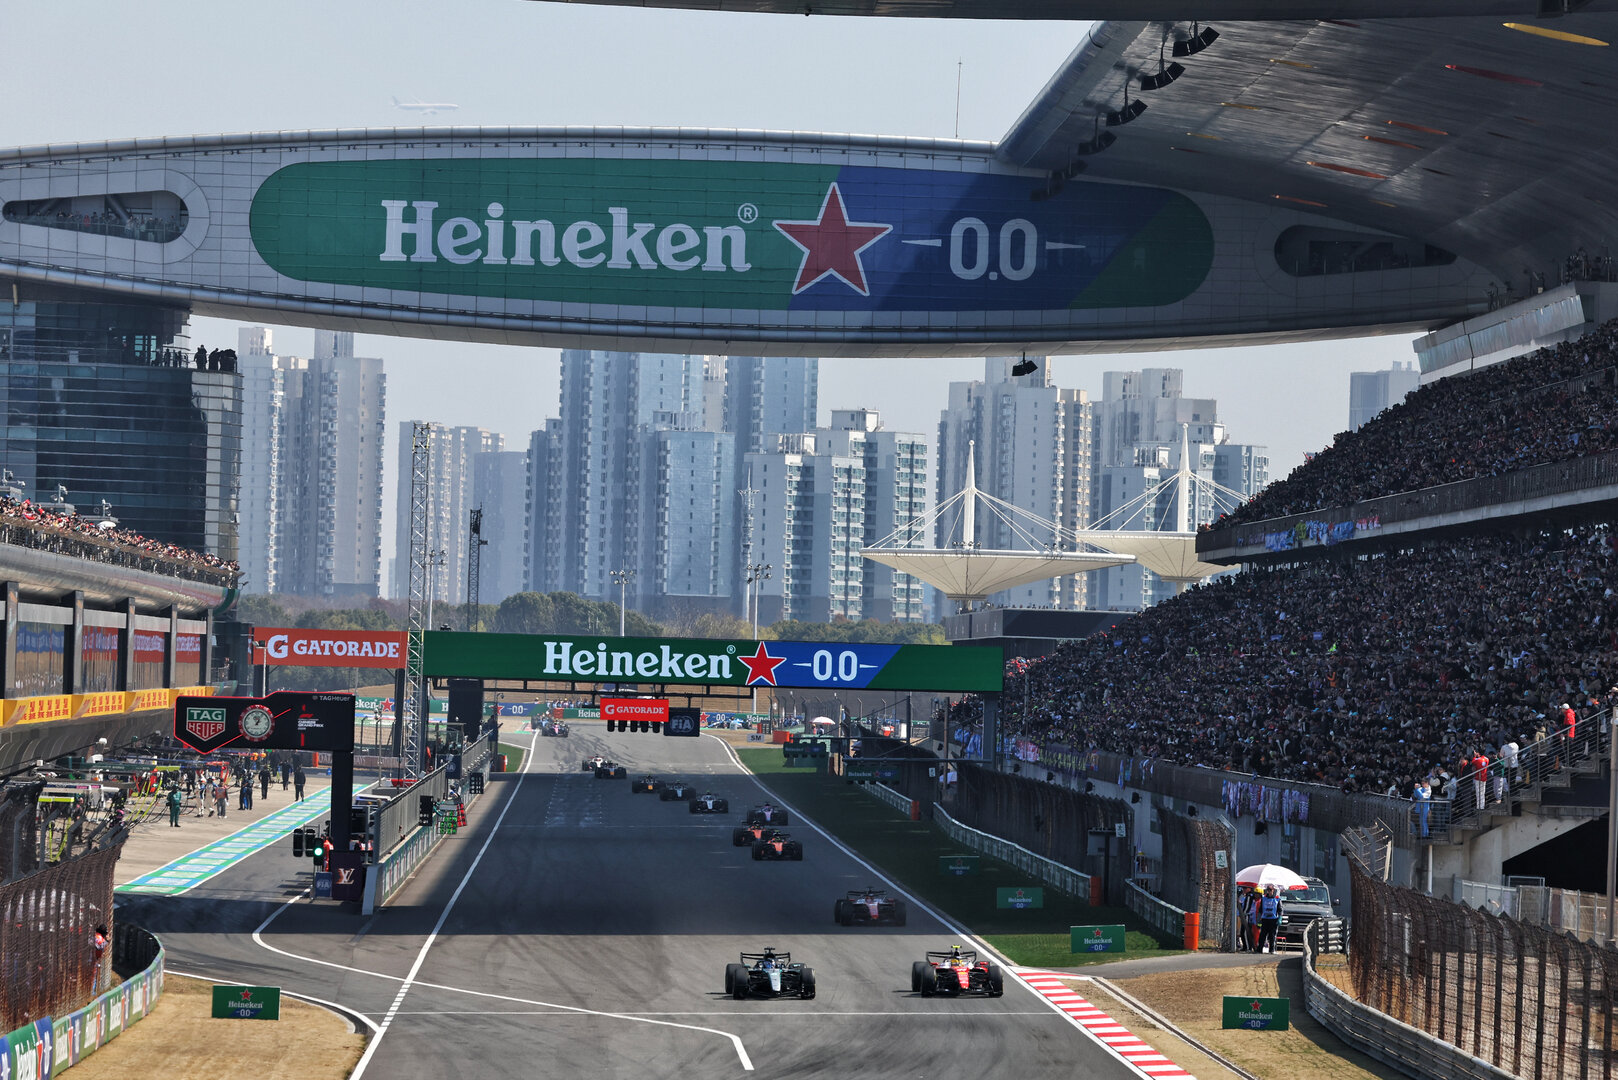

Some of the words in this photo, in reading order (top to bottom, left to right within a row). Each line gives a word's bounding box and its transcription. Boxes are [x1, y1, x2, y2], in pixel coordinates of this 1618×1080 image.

[950, 217, 1037, 280] 0.0
[293, 640, 399, 658] GATORADE
[813, 649, 858, 682] 0.0
[189, 710, 223, 721] TAG
[616, 706, 665, 715] GATORADE
[188, 722, 224, 739] HEUER
[1084, 937, 1112, 945] Heineken
[228, 1001, 263, 1009] Heineken
[1238, 1011, 1273, 1020] Heineken
